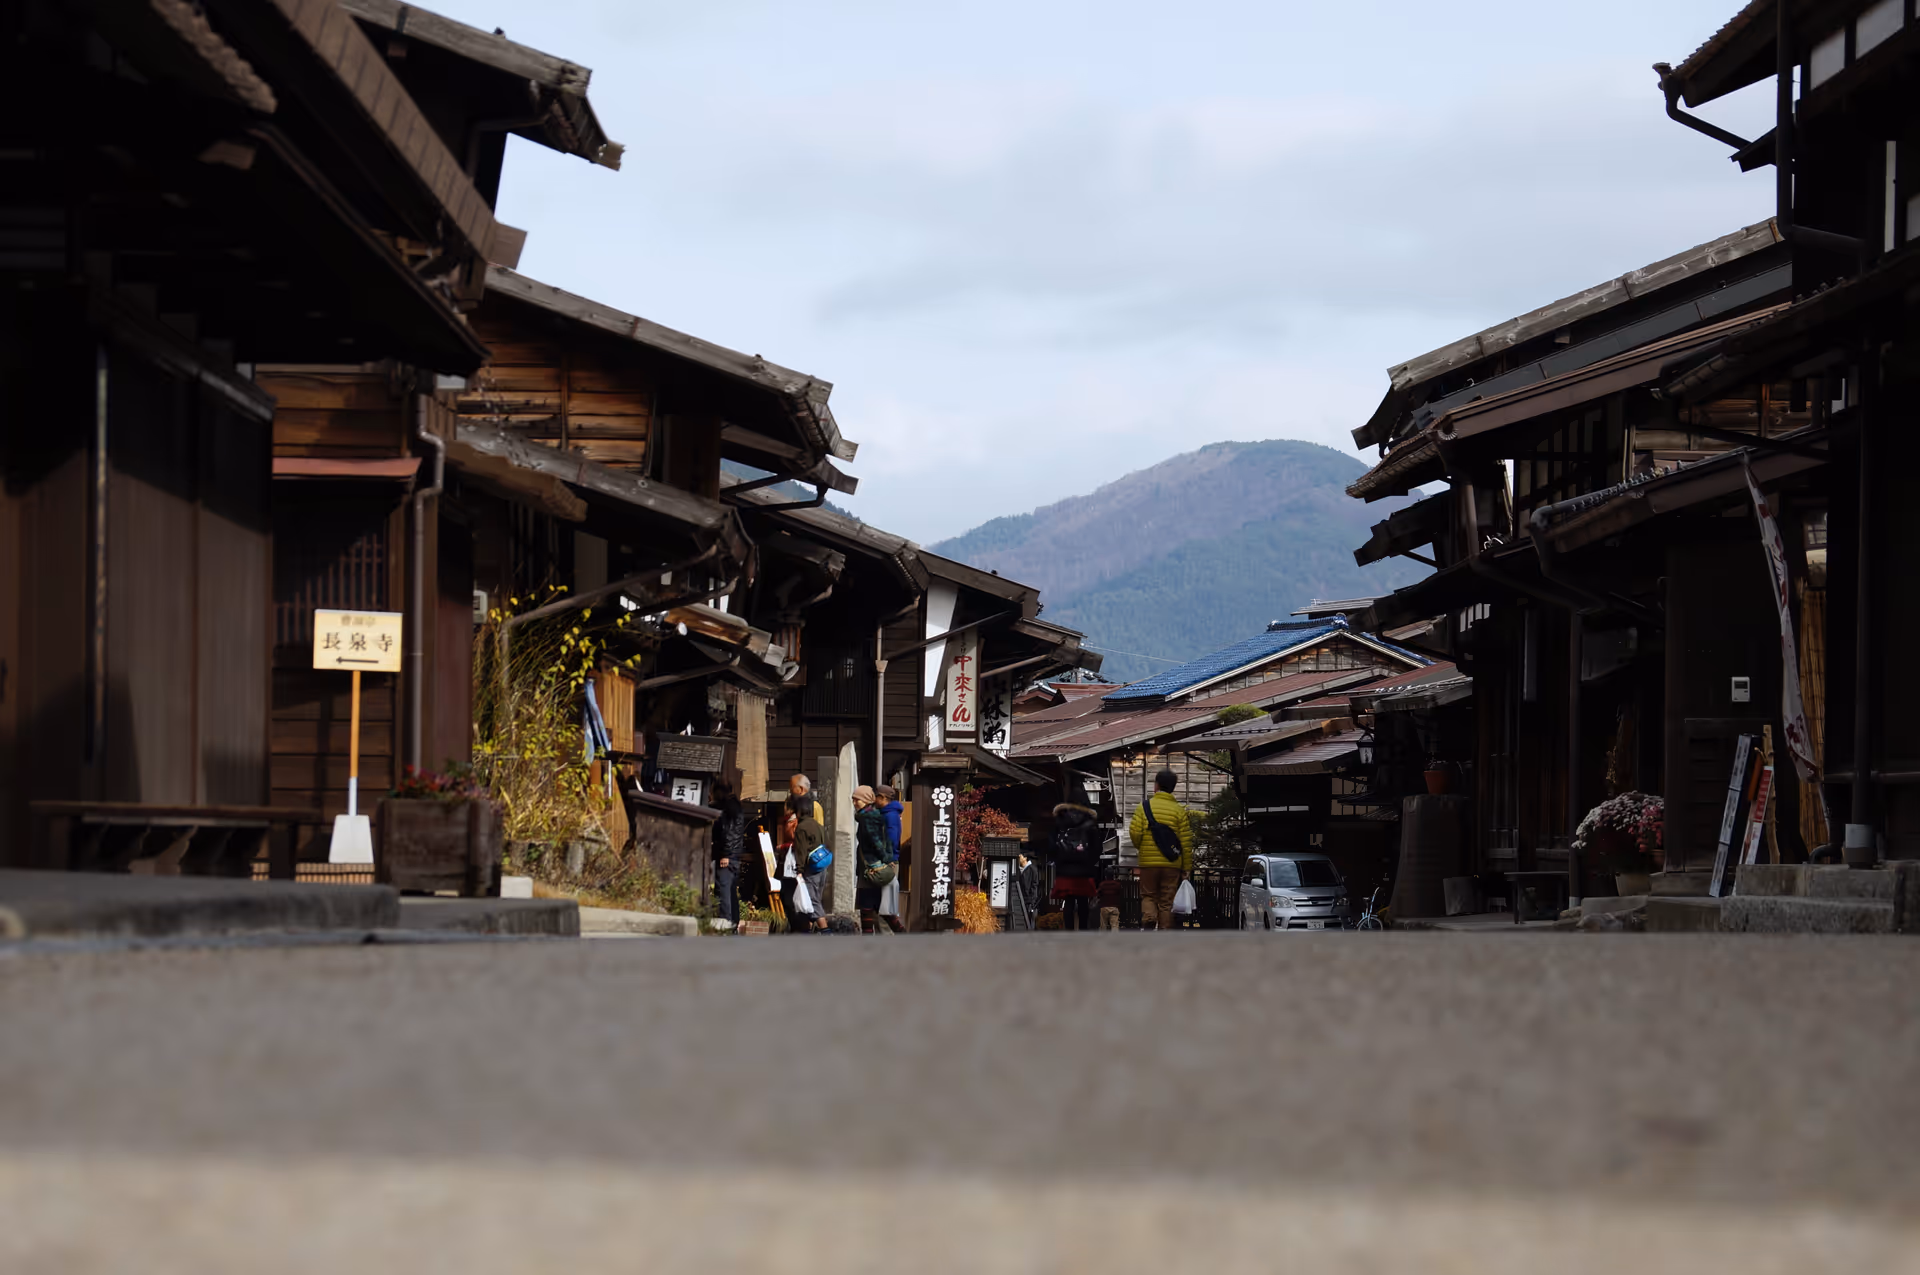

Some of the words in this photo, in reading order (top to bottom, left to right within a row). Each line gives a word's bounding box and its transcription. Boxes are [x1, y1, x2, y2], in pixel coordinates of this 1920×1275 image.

[321, 632, 393, 653] 長泉寺
[931, 808, 951, 915] 上問屋史料館
